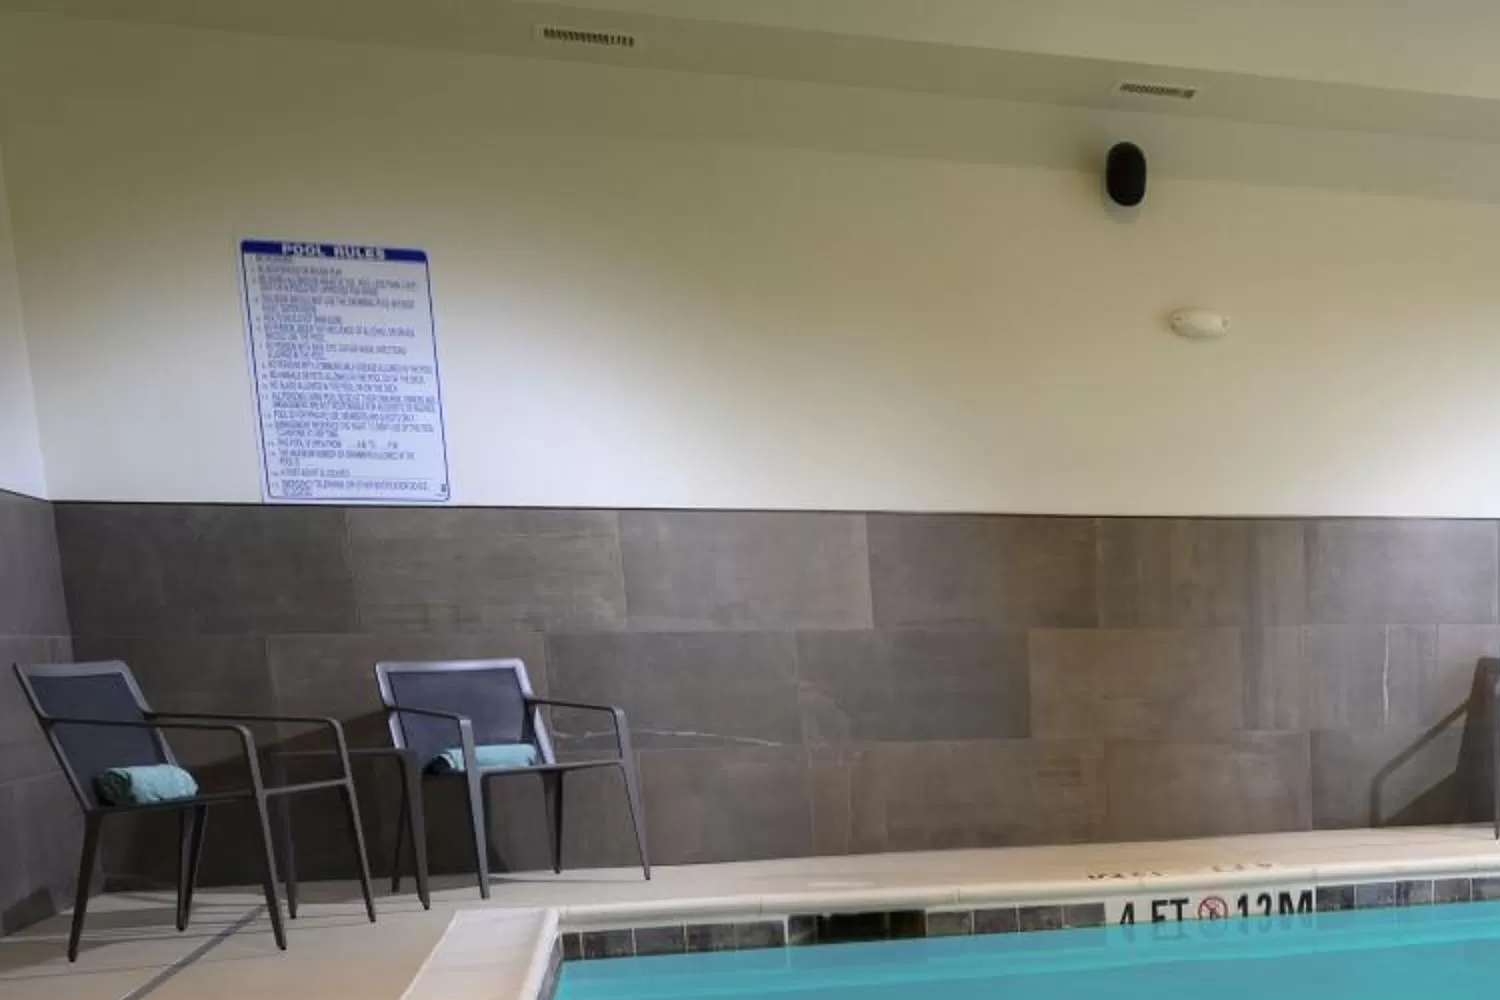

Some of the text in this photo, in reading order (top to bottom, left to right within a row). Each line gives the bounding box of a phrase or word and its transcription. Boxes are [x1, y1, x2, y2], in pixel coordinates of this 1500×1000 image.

[282, 241, 322, 257] POOL
[1119, 901, 1136, 926] 4
[1151, 897, 1190, 924] FT
